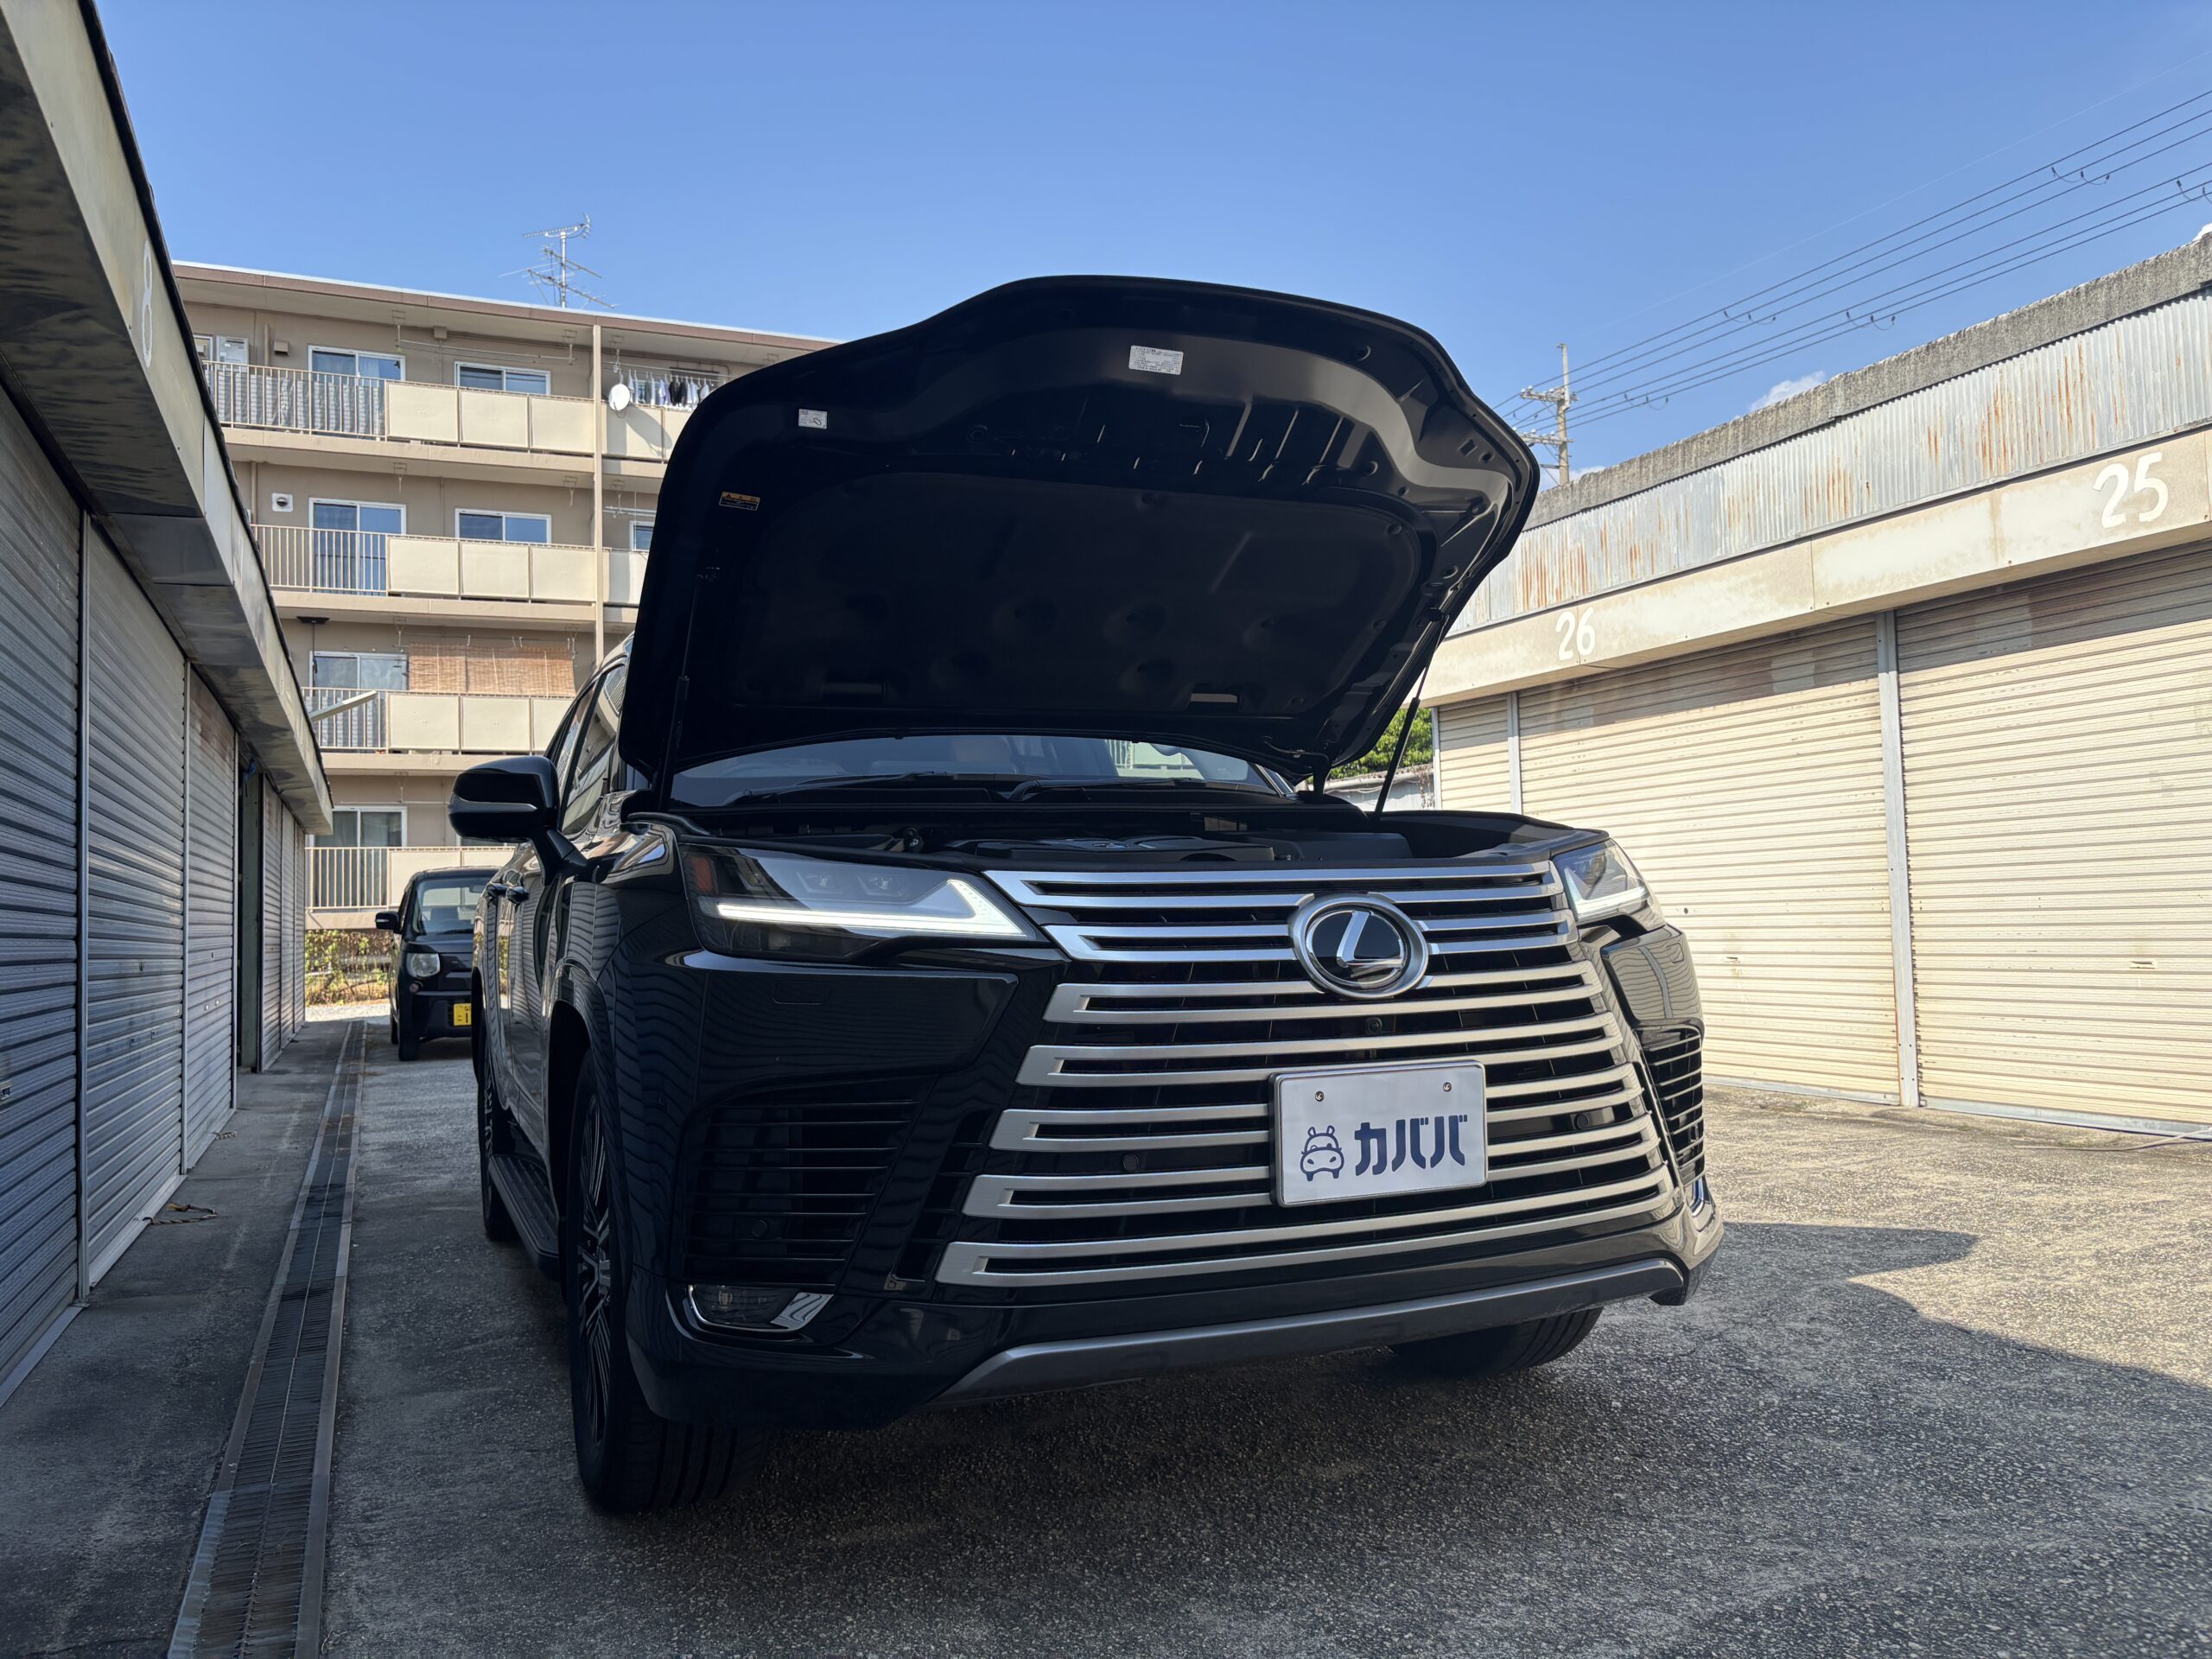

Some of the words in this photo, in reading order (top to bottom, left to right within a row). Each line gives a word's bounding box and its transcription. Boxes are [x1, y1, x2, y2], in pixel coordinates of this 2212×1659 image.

[142, 239, 153, 369] 8
[2093, 451, 2168, 529] 25
[1555, 607, 1596, 661] 26
[1354, 1115, 1468, 1176] カババ
